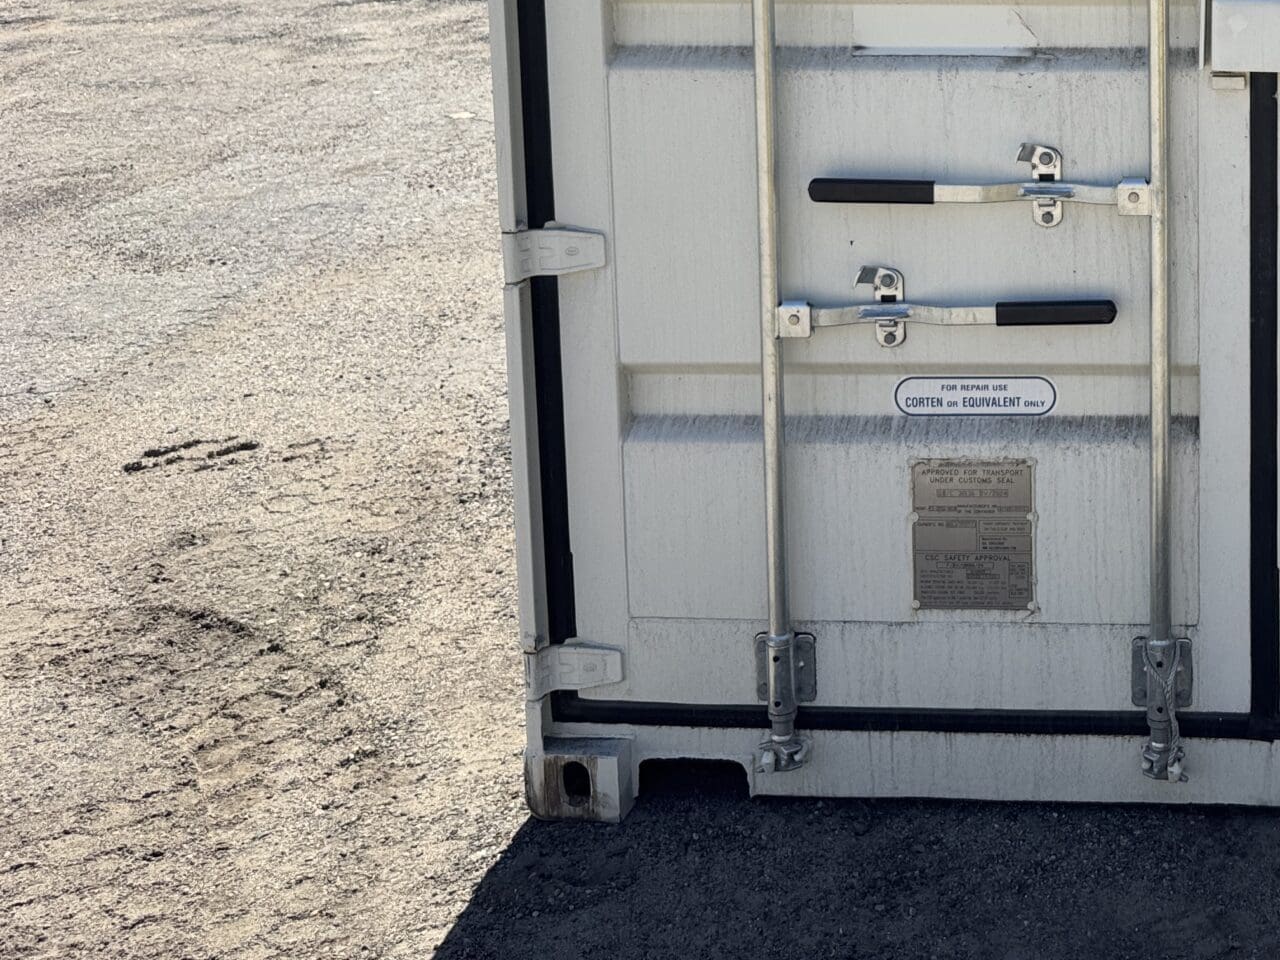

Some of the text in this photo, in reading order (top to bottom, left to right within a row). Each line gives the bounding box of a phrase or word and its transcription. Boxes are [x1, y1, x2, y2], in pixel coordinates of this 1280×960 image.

[905, 396, 1046, 408] CORTEN OR EQUIVALENT ONLY
